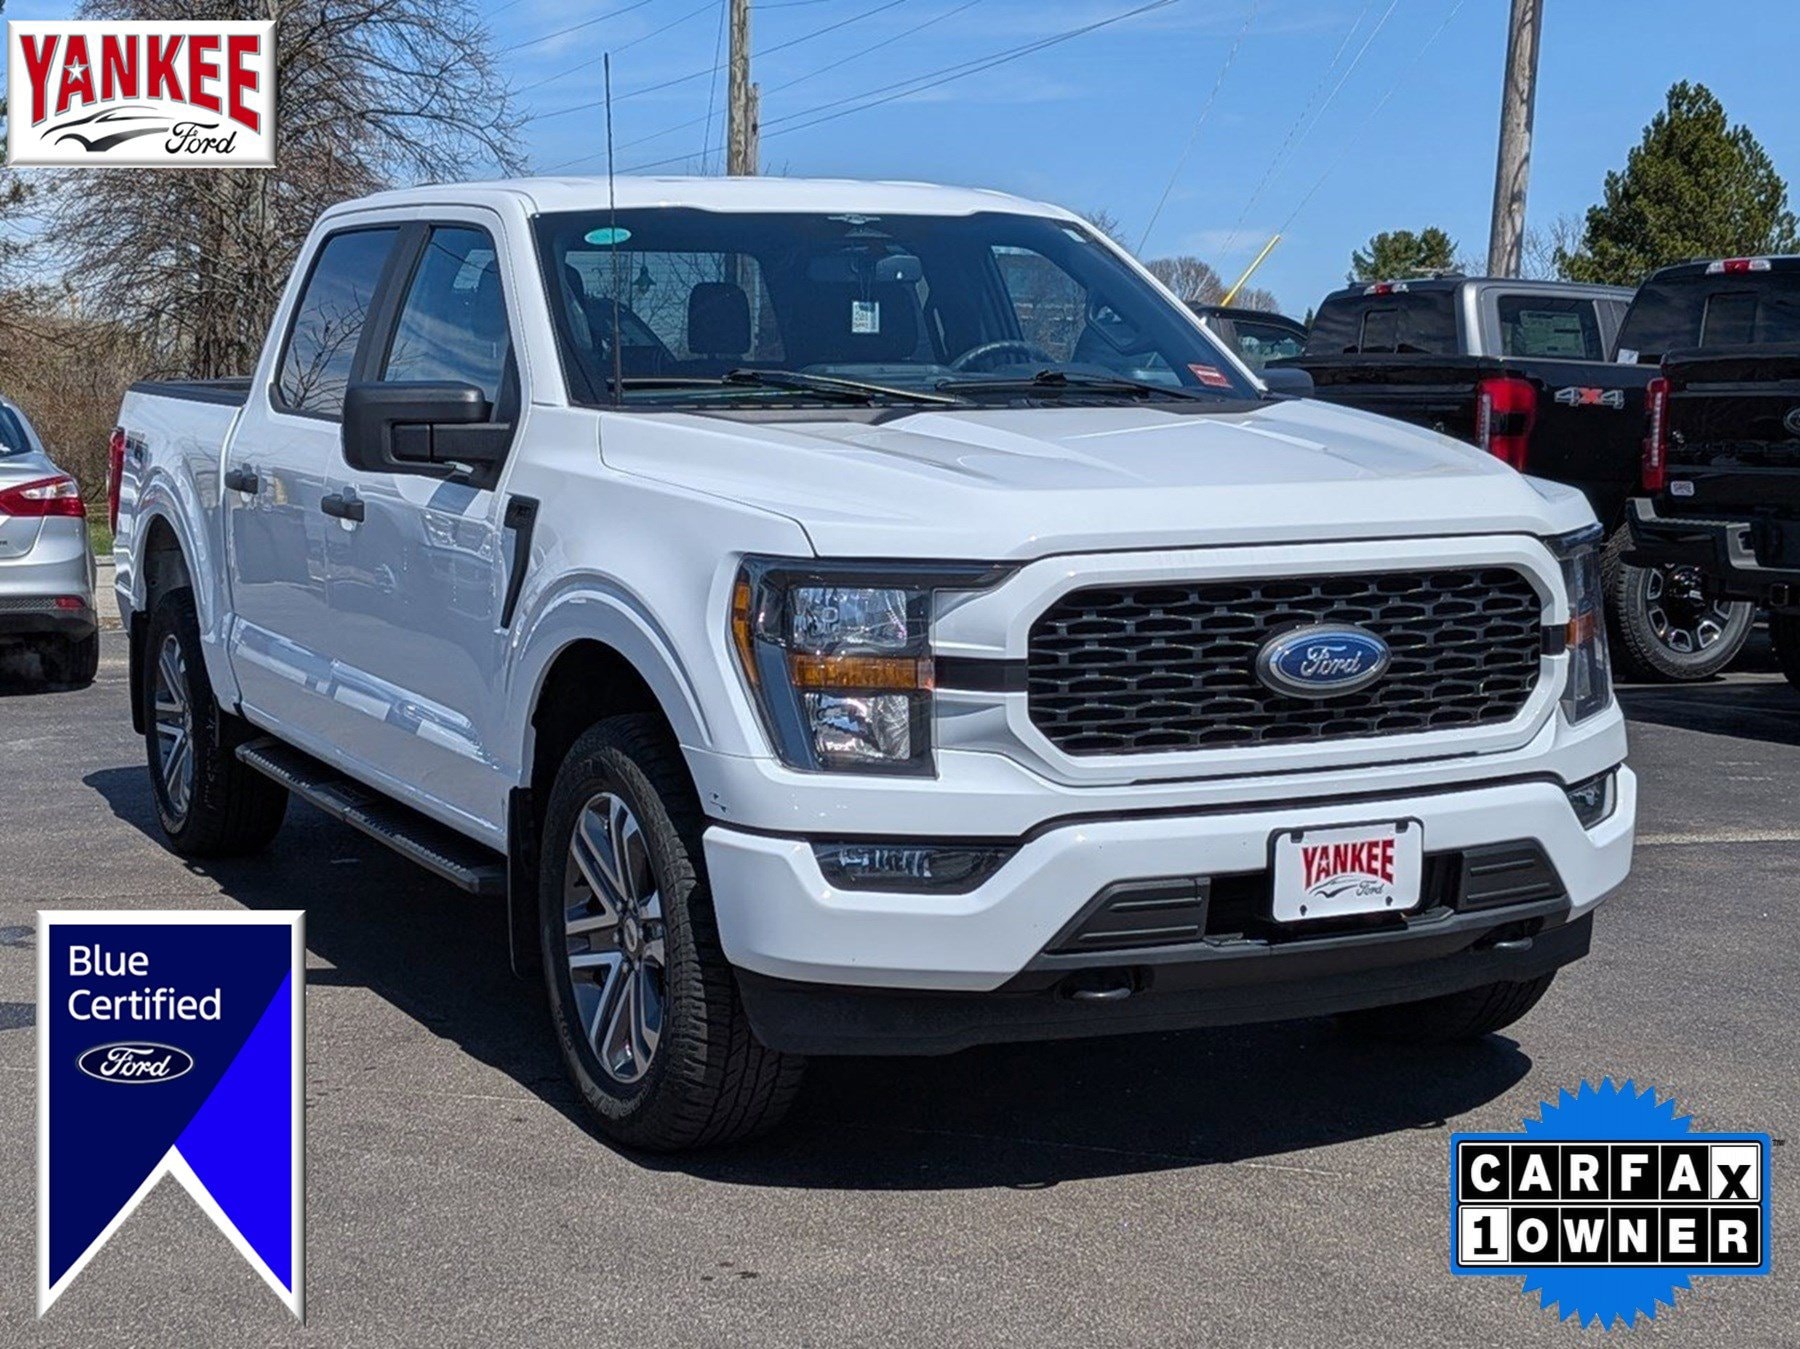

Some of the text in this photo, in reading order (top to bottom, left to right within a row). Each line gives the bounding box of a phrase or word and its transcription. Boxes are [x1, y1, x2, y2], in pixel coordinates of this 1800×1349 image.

[1300, 645, 1362, 677] Ford
[1302, 838, 1395, 891] YANKEE
[1356, 880, 1384, 896] Ford
